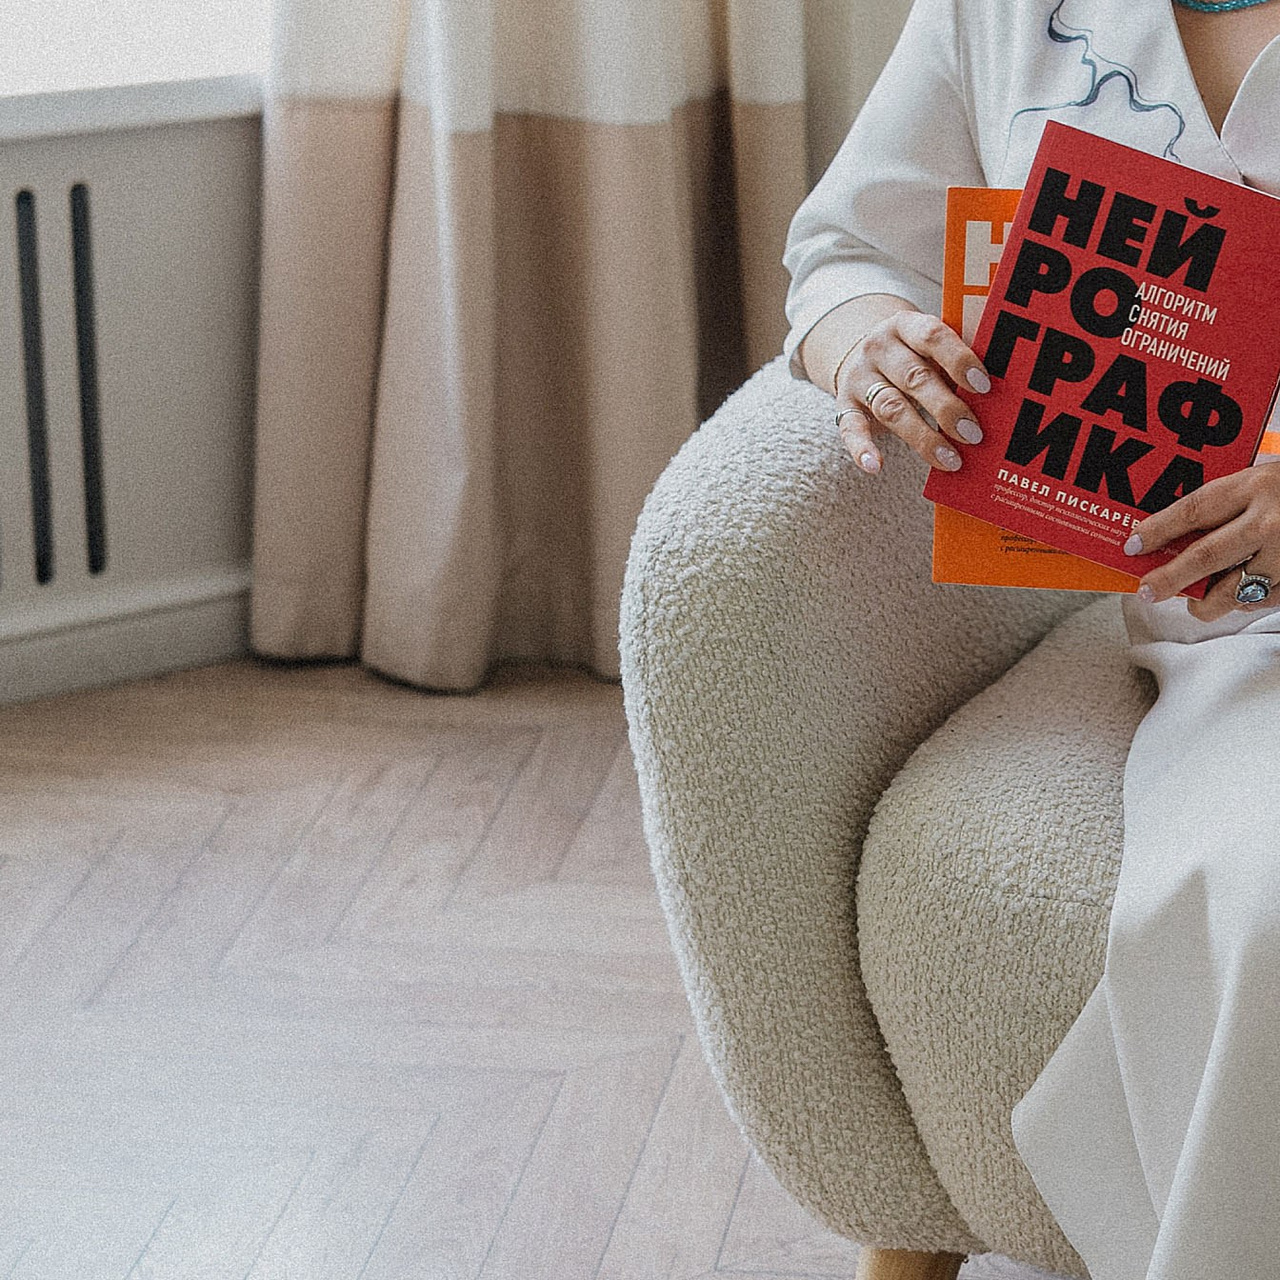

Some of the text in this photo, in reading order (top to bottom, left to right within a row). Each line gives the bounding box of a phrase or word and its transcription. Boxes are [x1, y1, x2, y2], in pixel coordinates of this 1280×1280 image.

[1027, 167, 1227, 292] НЕЙ
[1004, 238, 1141, 338] РО
[1134, 281, 1218, 325] АЛГОРИТМ
[1128, 304, 1190, 340] СНЯТИЯ
[983, 310, 1243, 452] ГРАФ
[1121, 327, 1230, 381] ОГРАНИЧЕНИЙ
[997, 468, 1051, 497] ПАВЕЛ
